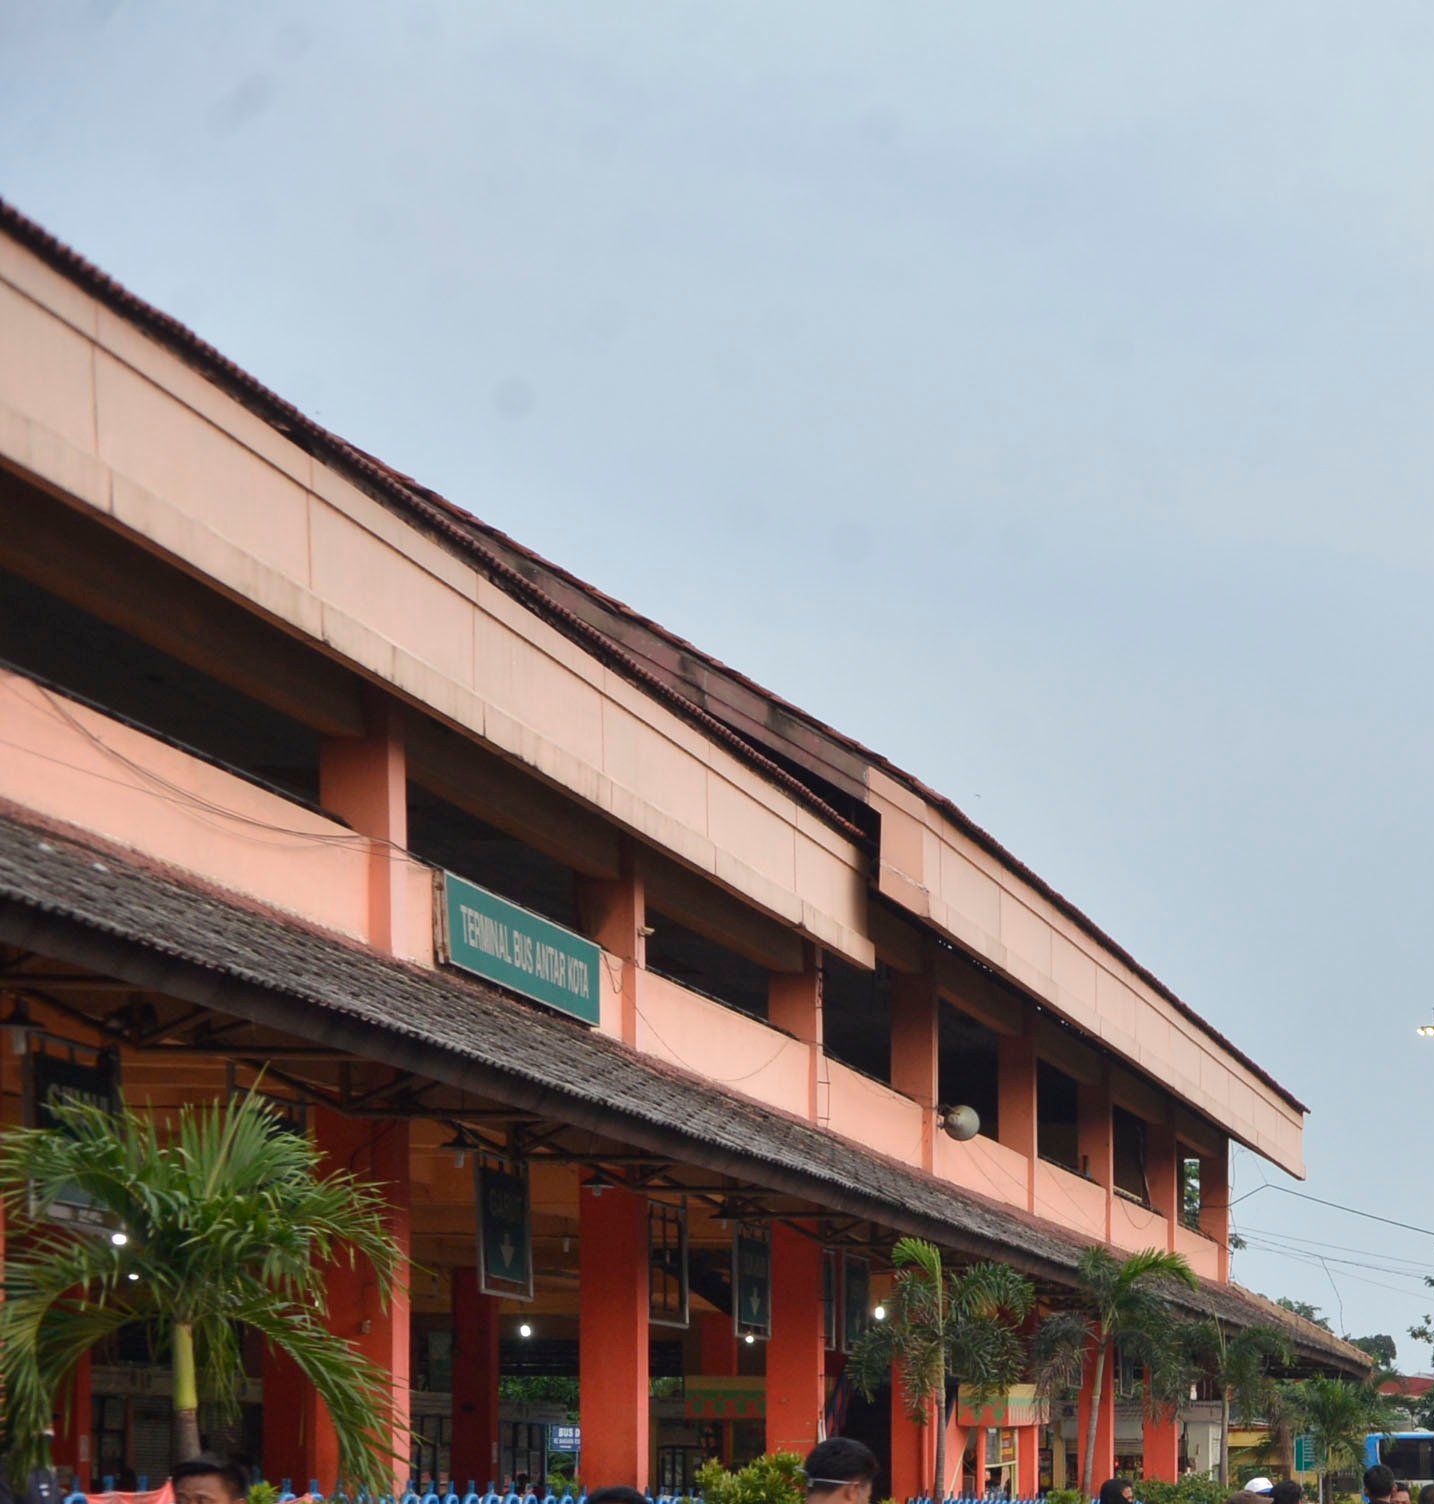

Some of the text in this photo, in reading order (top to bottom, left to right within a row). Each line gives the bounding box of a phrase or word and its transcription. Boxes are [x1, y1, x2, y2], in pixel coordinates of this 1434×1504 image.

[460, 904, 589, 999] TERMINAL BUS ANTAR KOTA
